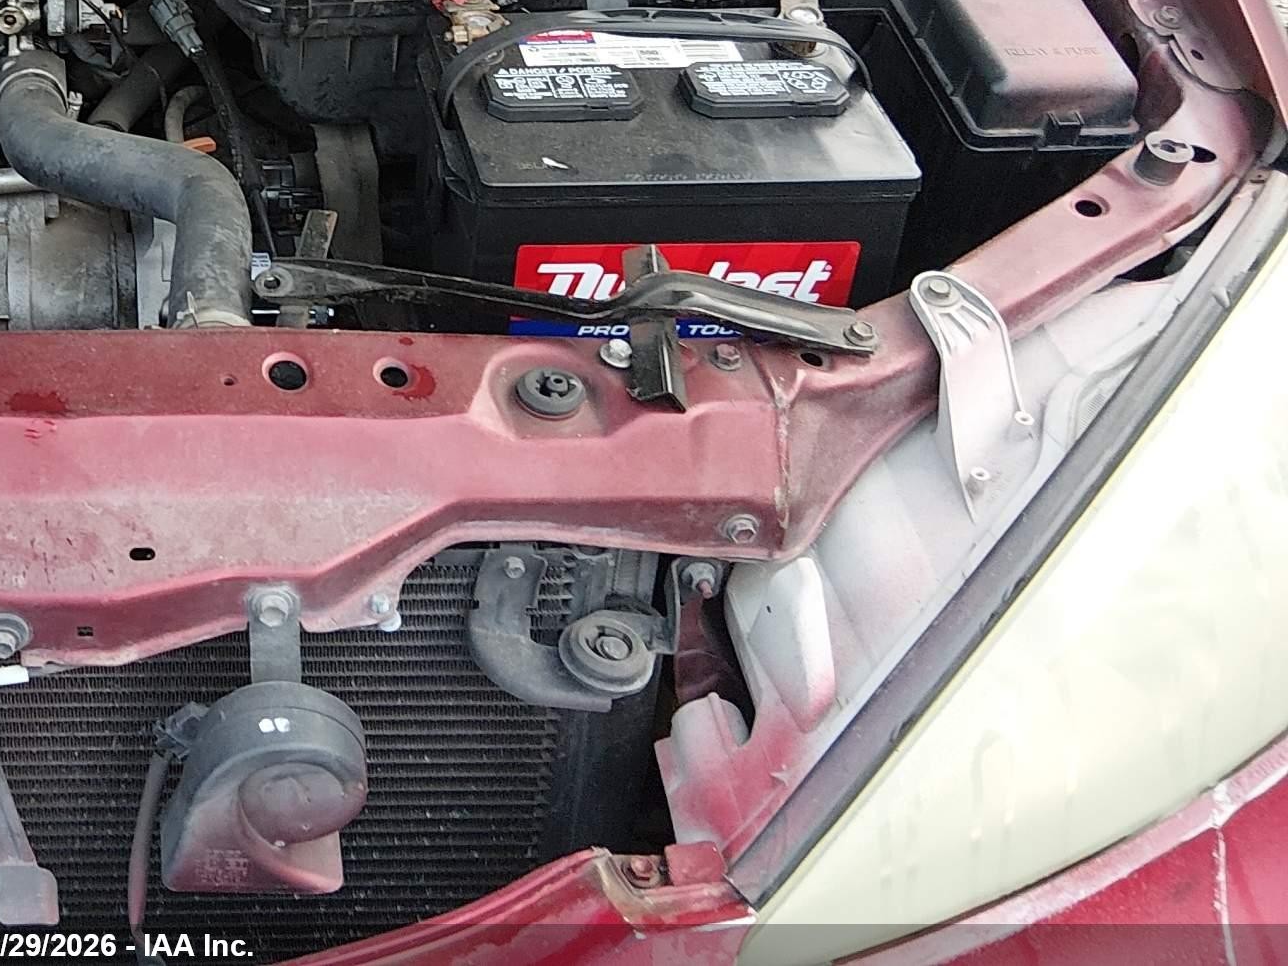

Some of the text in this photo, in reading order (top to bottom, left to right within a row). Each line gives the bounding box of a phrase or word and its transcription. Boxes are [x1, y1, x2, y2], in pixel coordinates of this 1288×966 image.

[508, 67, 558, 75] DANGER
[567, 66, 613, 74] POISON
[536, 260, 834, 303] Dust
[687, 324, 743, 336] TOU
